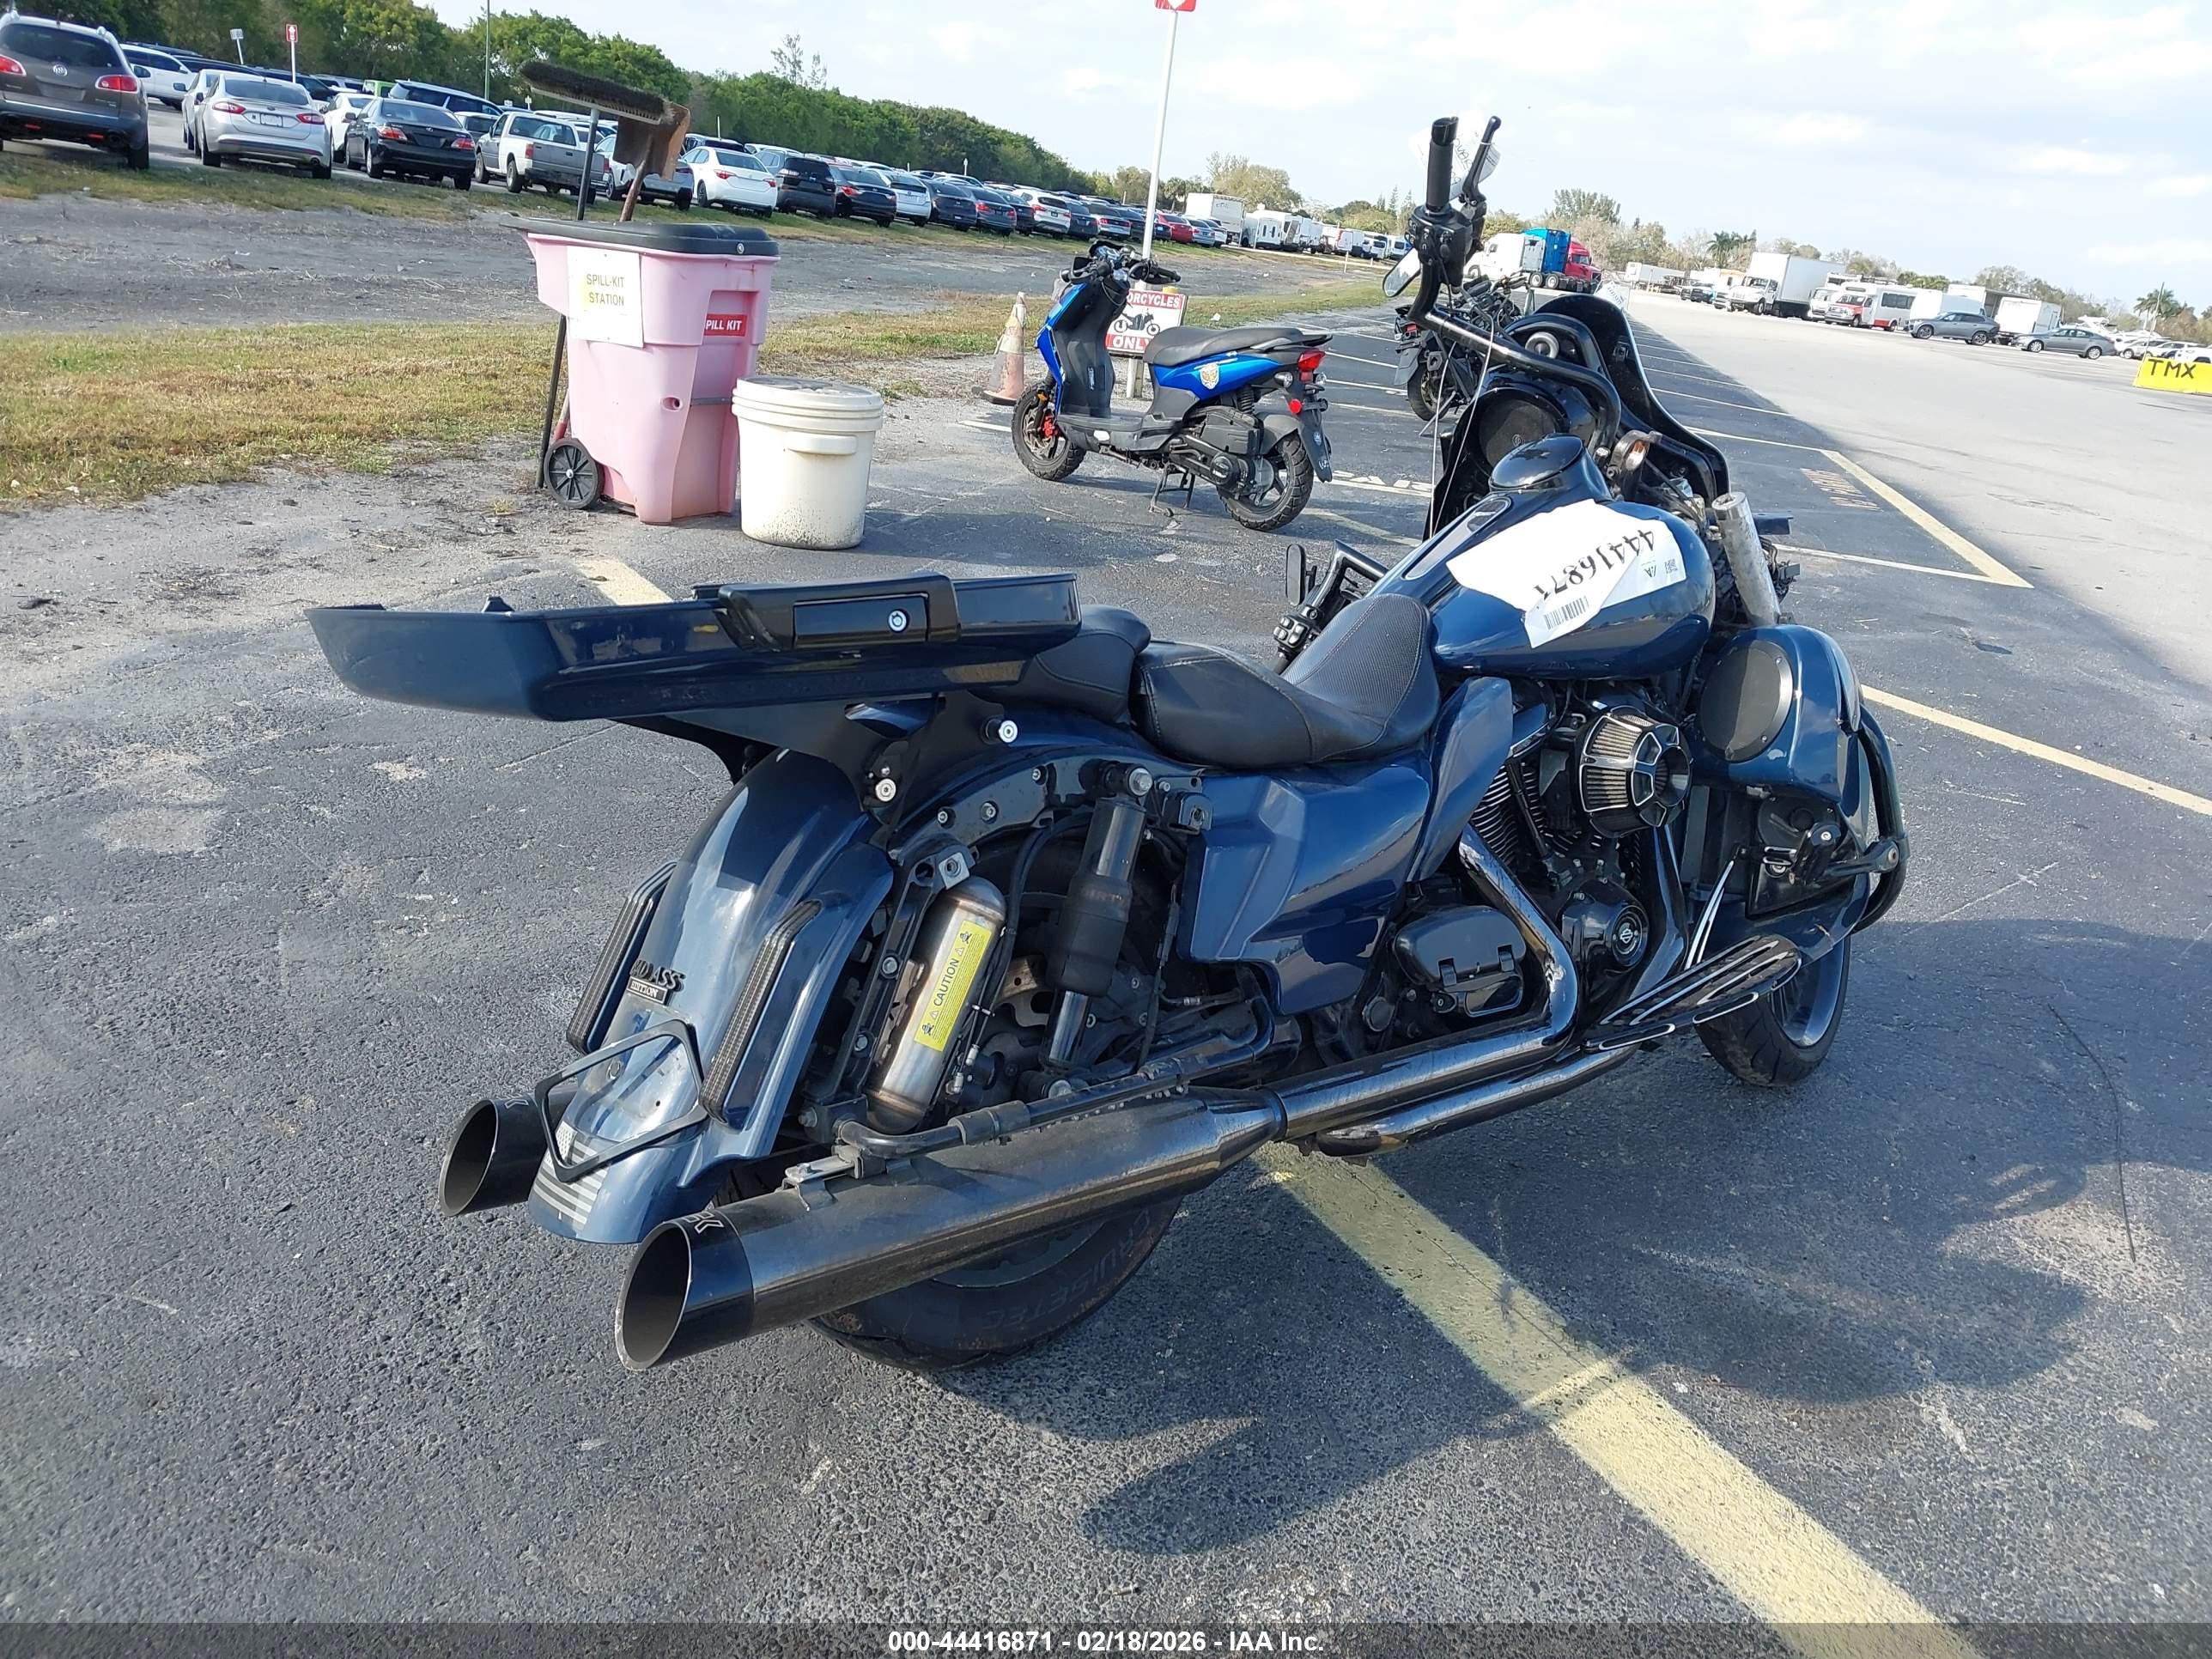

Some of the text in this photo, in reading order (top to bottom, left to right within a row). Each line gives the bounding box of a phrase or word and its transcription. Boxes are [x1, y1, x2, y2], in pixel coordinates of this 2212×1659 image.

[586, 273, 625, 289] SPILL-KIT
[588, 292, 625, 307] STATION
[1126, 292, 1181, 308] ORCYCLES
[705, 319, 743, 331] PILL KIT
[2148, 358, 2197, 380] TMX
[1534, 528, 1655, 601] 44416871
[629, 981, 659, 998] EDITION
[933, 957, 960, 1006] CAUTION
